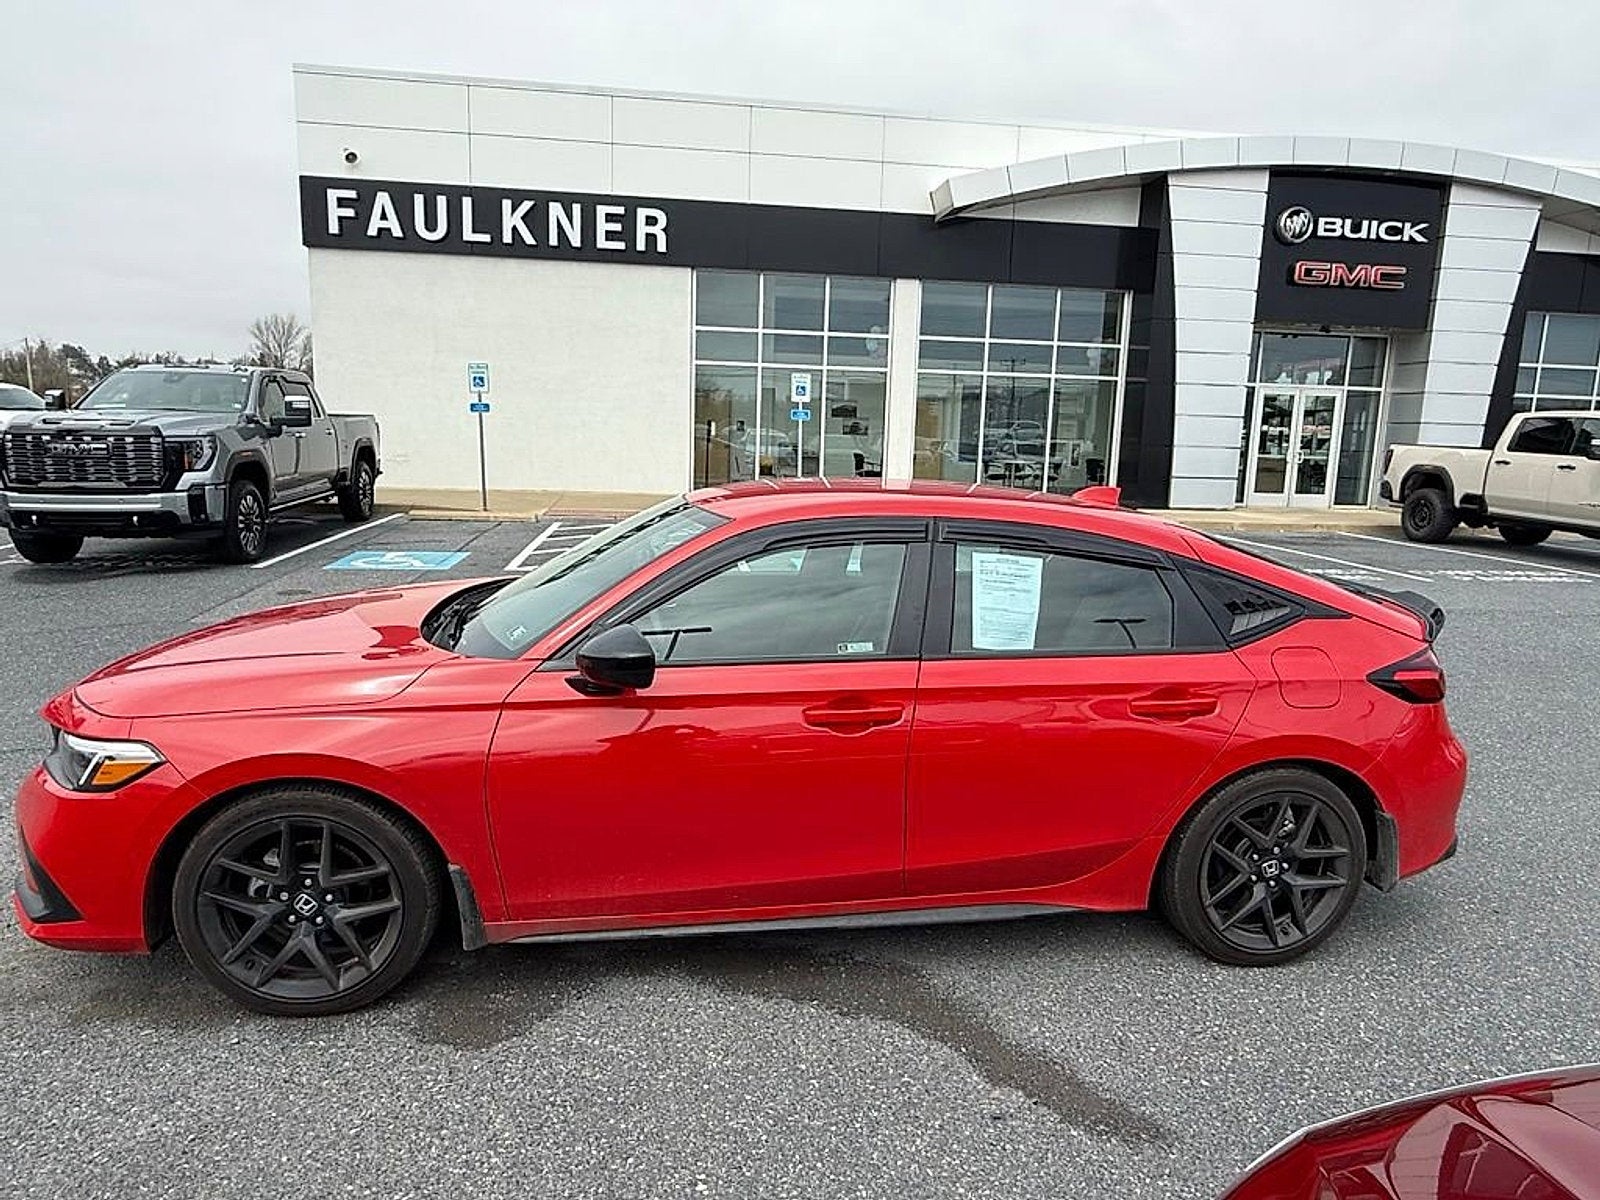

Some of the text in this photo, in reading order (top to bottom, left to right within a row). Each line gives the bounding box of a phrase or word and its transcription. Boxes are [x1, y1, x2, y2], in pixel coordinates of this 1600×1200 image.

[326, 187, 668, 253] FAULKNER
[1317, 216, 1430, 244] BUICK
[1293, 260, 1407, 289] GMC
